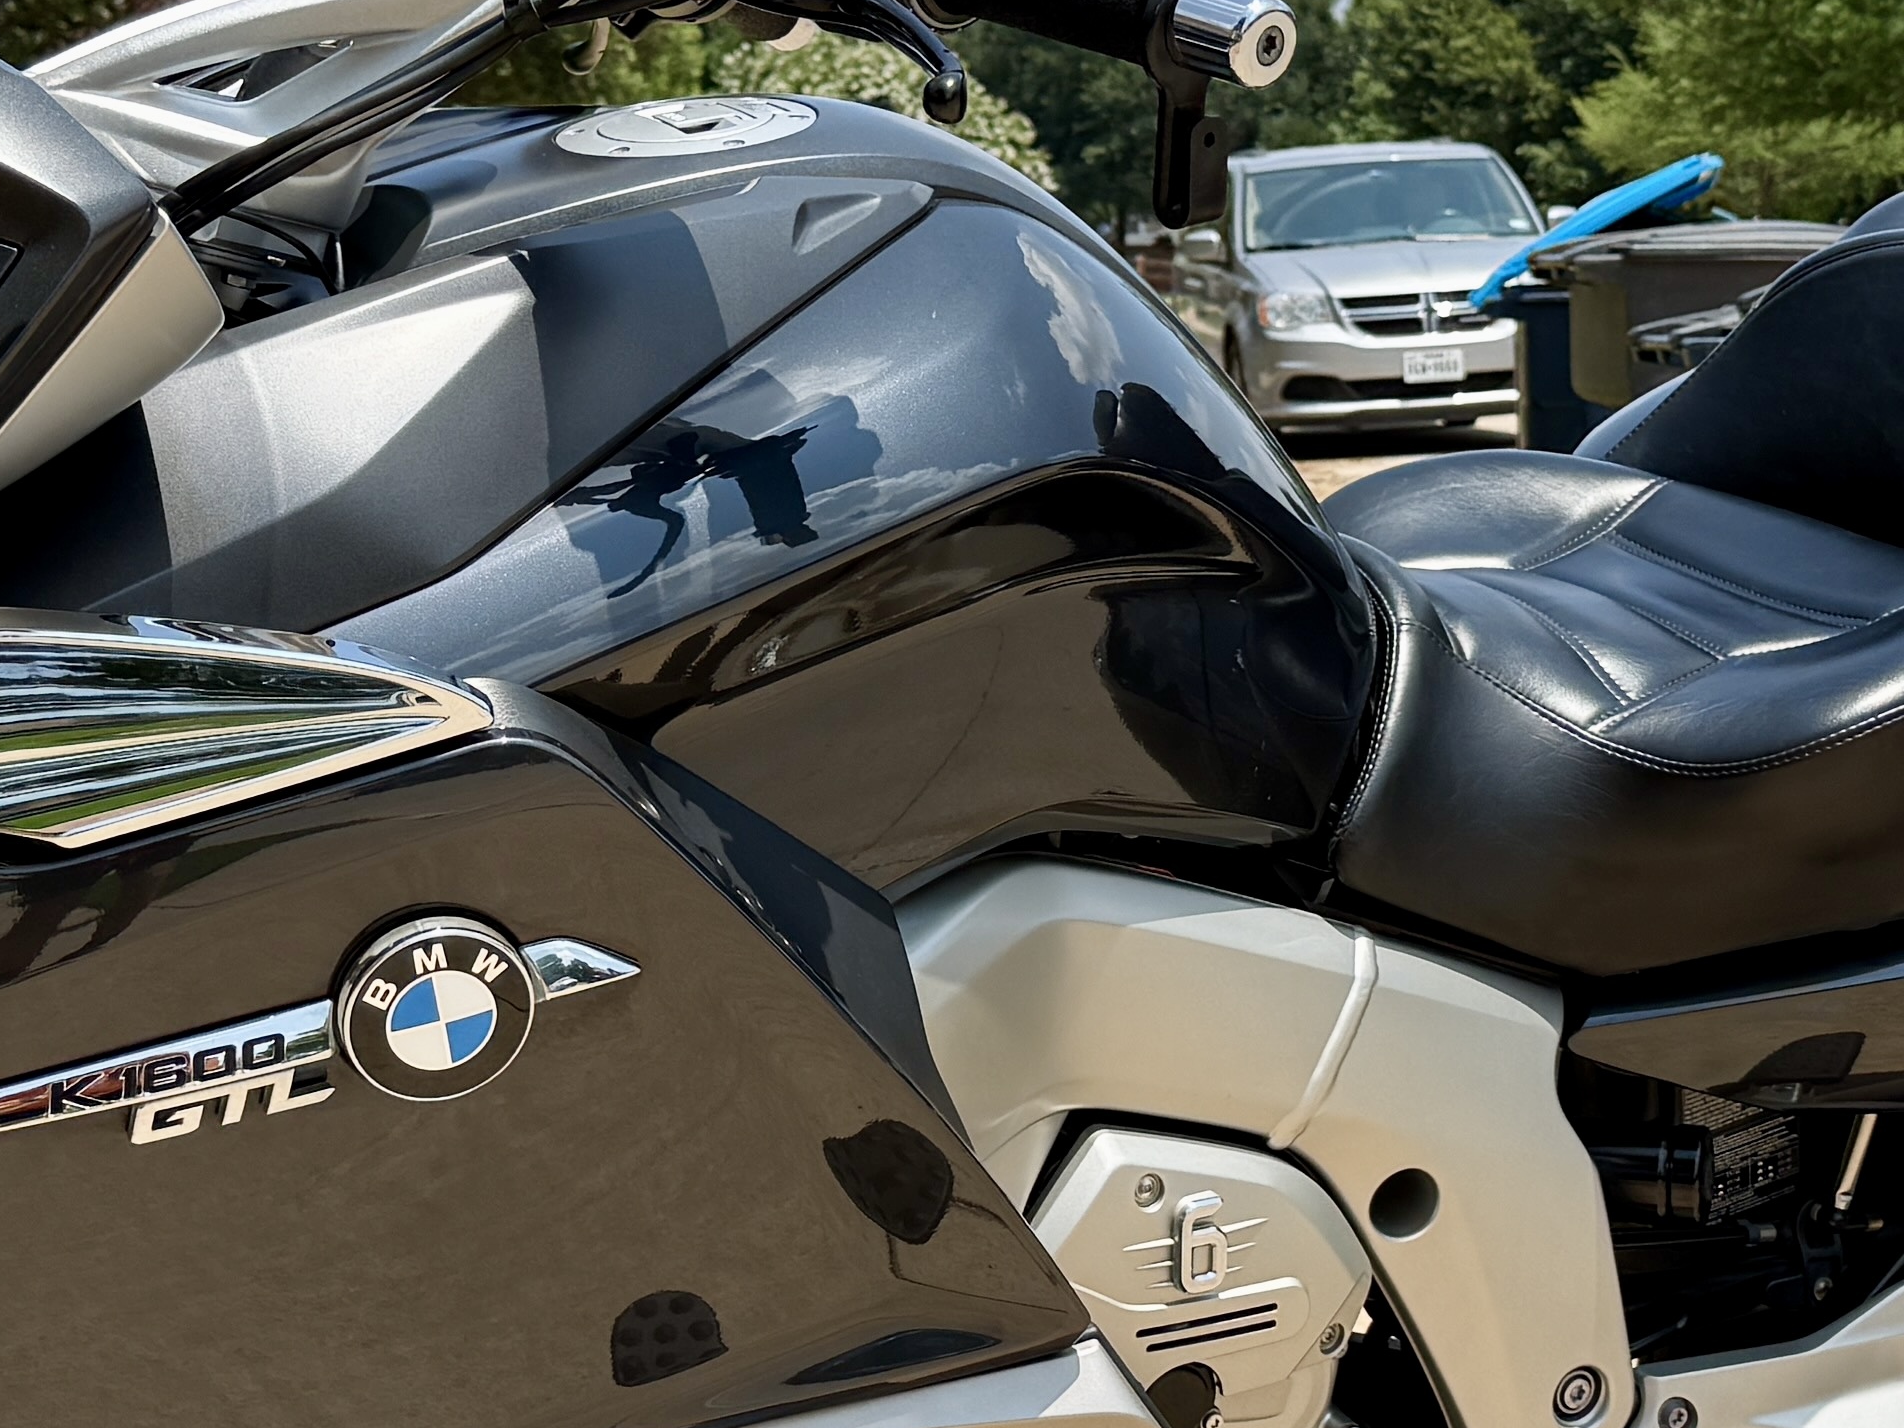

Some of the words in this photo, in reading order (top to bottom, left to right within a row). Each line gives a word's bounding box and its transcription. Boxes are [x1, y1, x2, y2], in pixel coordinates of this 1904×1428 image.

[361, 942, 509, 1012] BMW
[129, 1068, 336, 1146] GTL
[1174, 1189, 1228, 1294] 6
